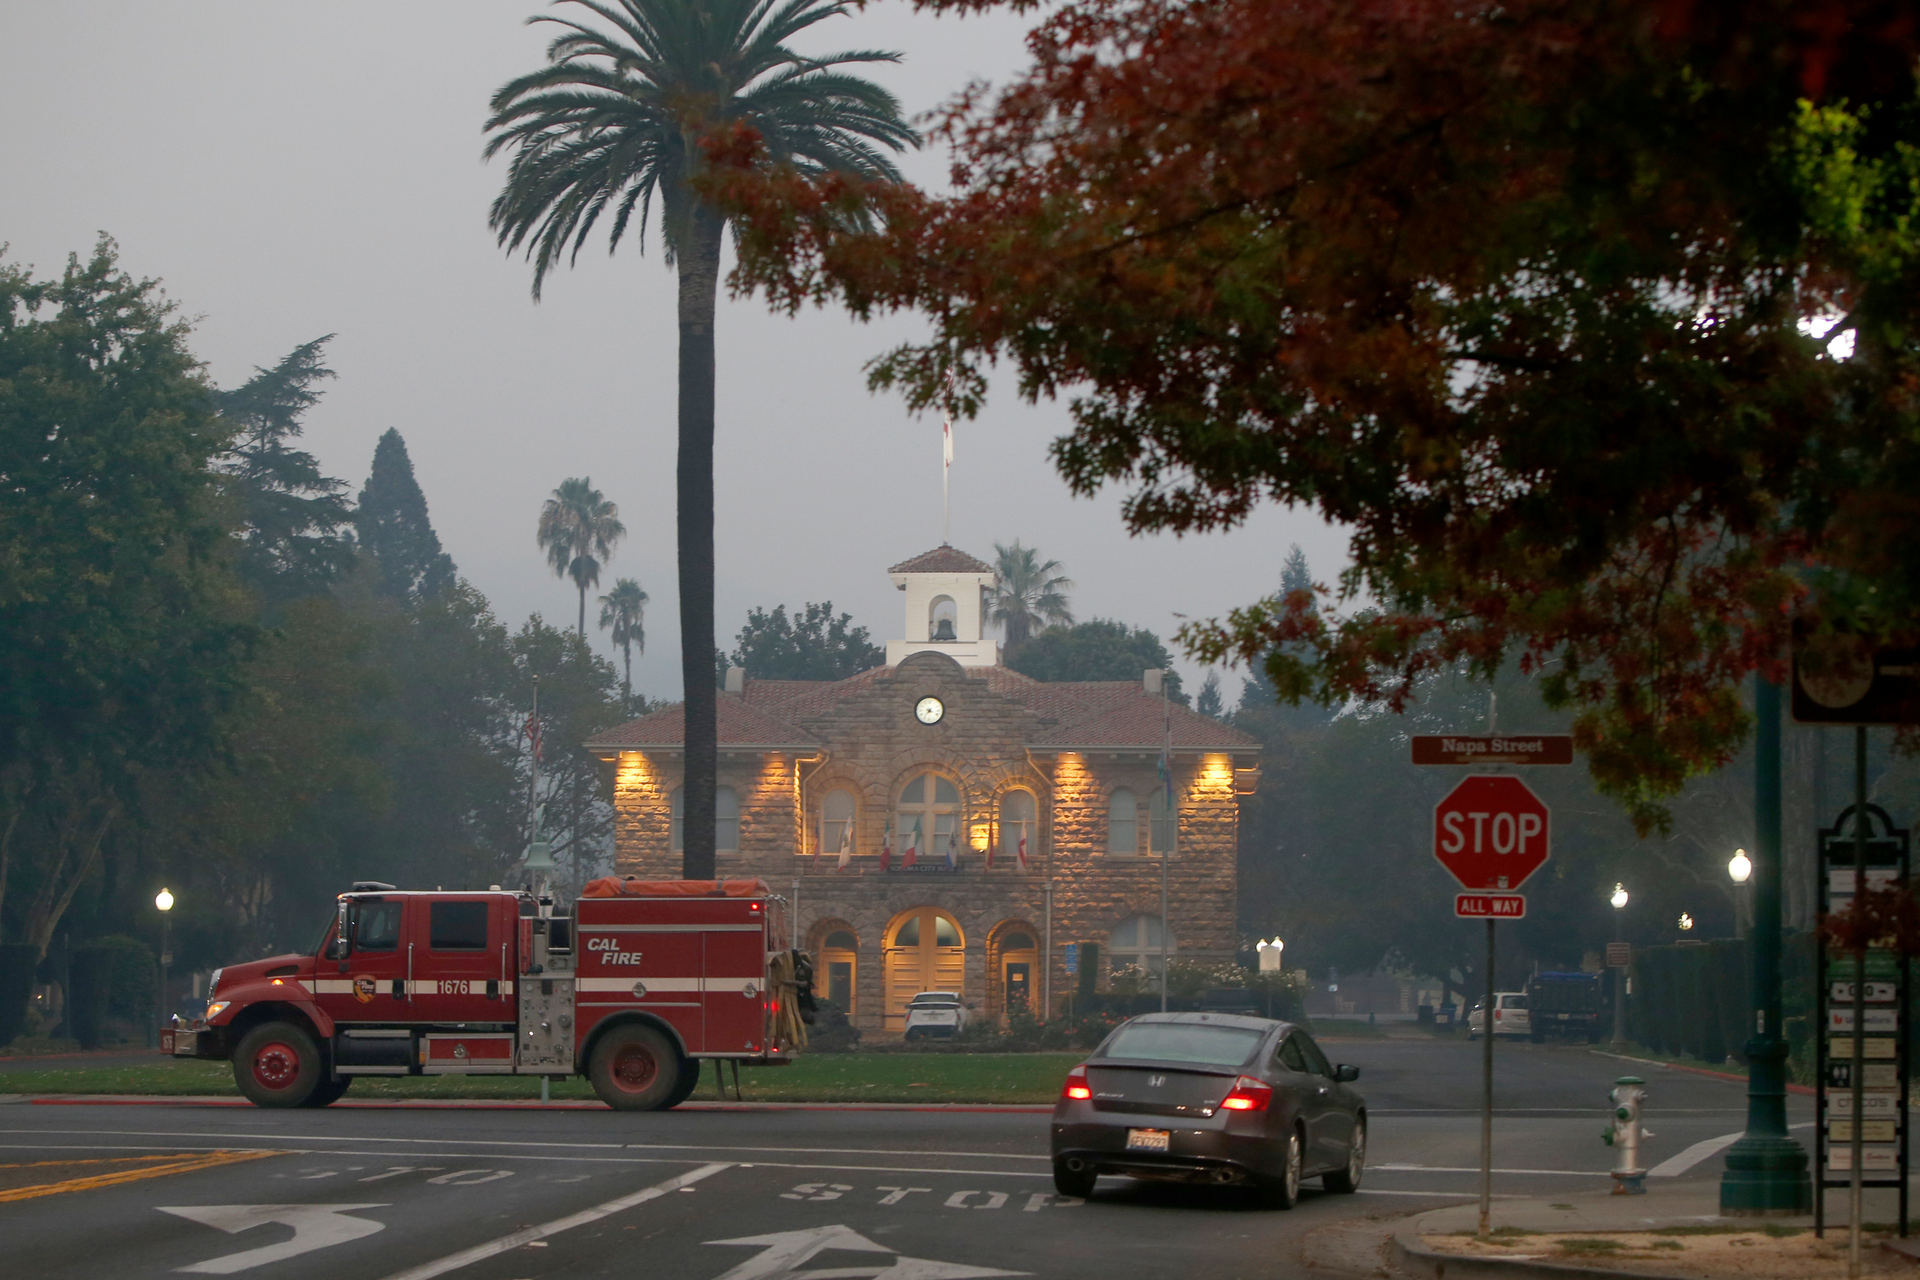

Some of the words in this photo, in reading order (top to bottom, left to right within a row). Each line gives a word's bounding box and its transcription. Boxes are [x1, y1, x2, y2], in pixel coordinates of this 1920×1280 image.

[1441, 738, 1487, 756] Napa
[1490, 738, 1544, 753] Street
[1441, 810, 1542, 855] STOP
[1460, 898, 1486, 914] ALL
[1491, 898, 1520, 914] WAY
[587, 938, 620, 951] CAL
[601, 952, 643, 965] FIRE
[438, 979, 468, 994] 1676
[1837, 1096, 1889, 1108] chco's
[779, 1182, 1087, 1213] STOP
